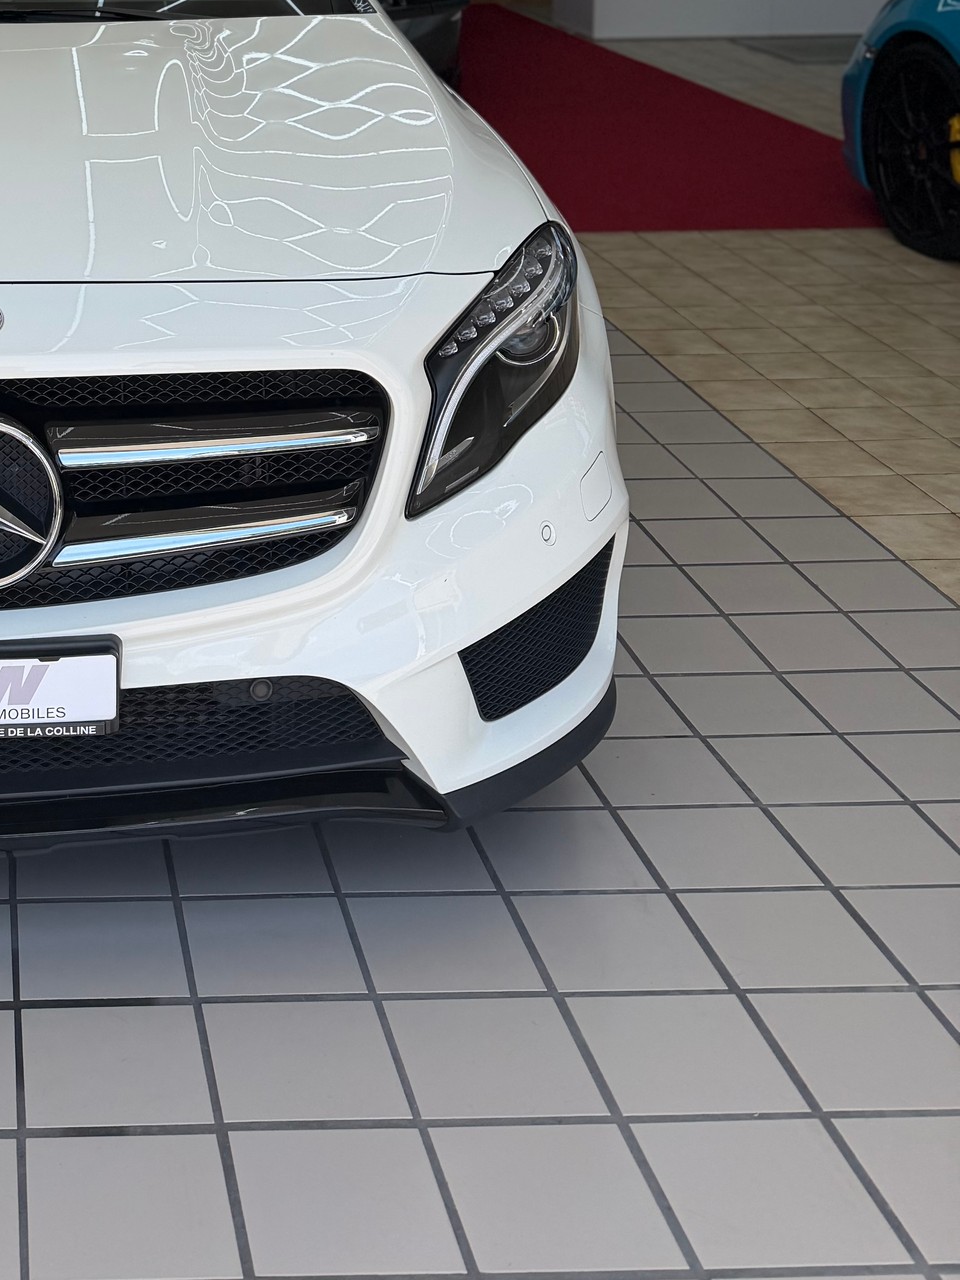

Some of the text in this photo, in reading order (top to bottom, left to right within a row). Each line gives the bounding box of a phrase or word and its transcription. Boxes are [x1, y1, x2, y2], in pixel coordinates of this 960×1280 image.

[8, 727, 25, 737] DE
[28, 726, 43, 736] LA
[46, 725, 97, 737] COLLINE
